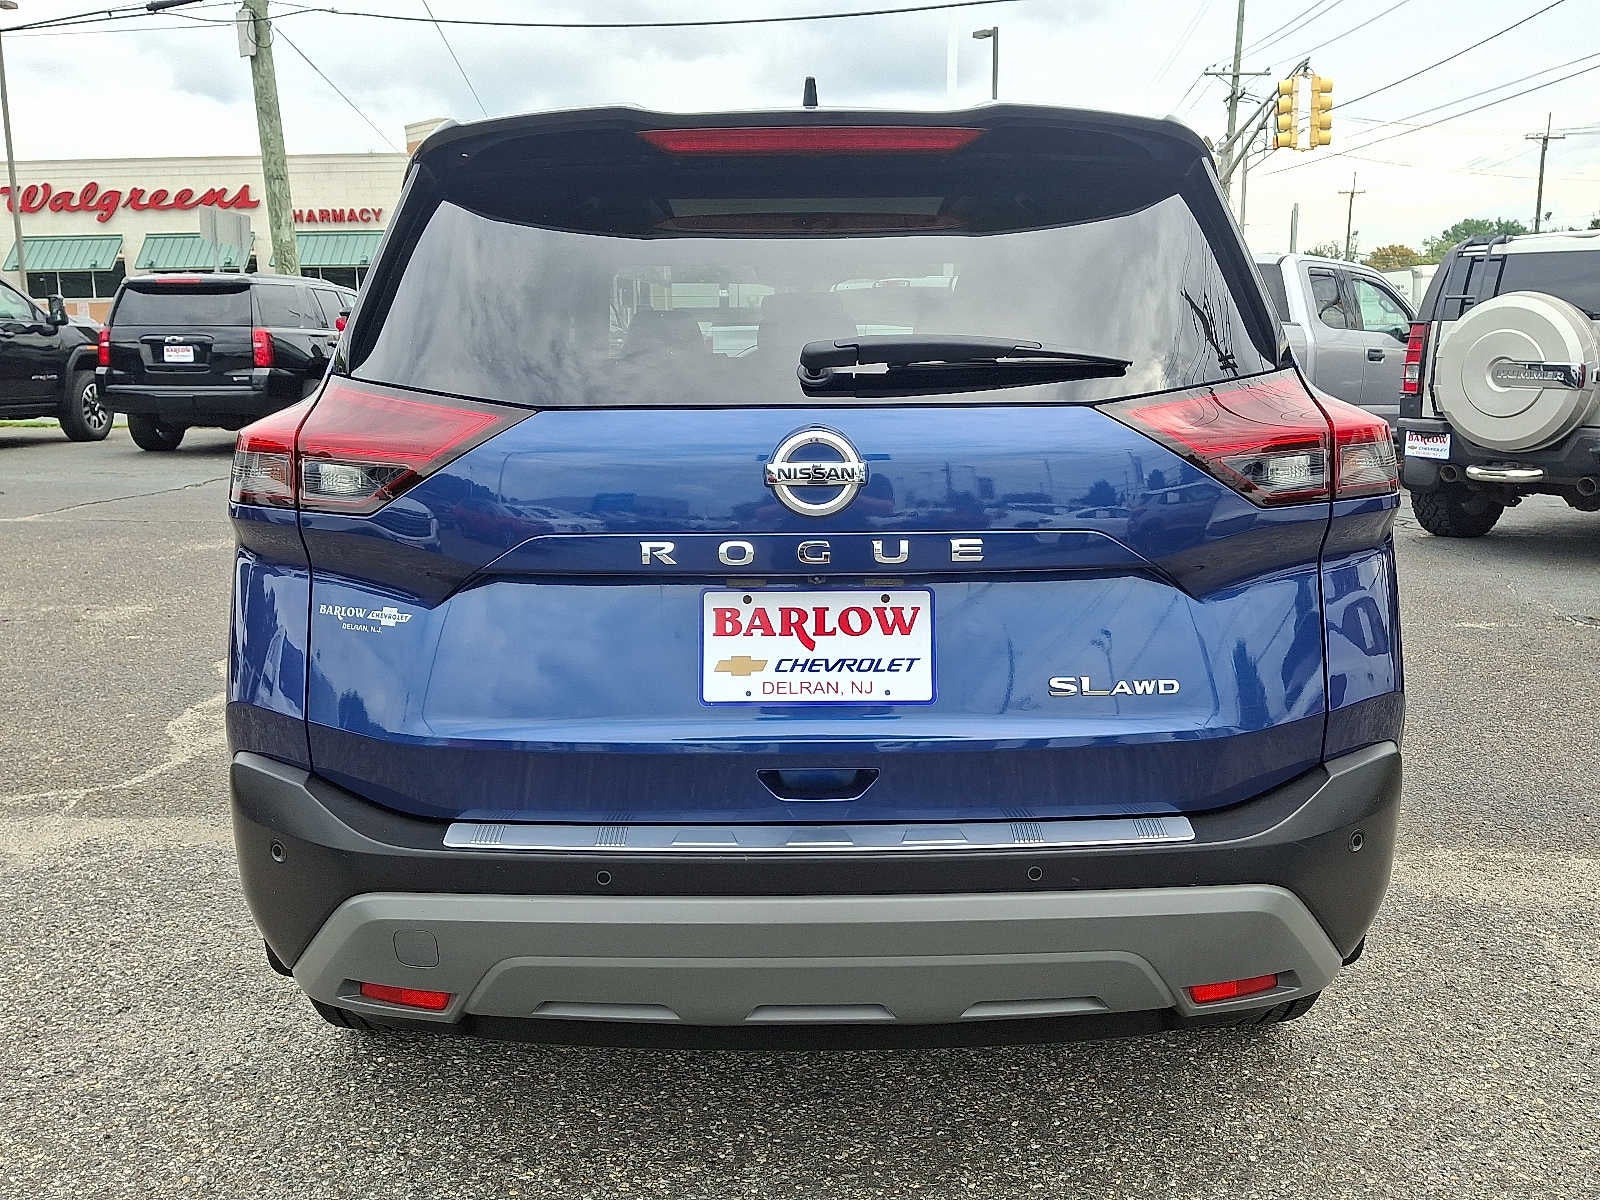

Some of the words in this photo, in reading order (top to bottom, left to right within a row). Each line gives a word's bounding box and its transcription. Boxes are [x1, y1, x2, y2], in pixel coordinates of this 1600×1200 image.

[0, 181, 261, 224] Walgreens
[292, 207, 383, 224] HARMACY
[1496, 369, 1565, 381] HUMMER
[1408, 432, 1448, 446] BARLOW
[776, 466, 856, 482] NISSAN
[638, 537, 985, 567] ROGUE
[319, 604, 368, 621] BARLOW
[370, 610, 410, 622] CHEVROLET
[712, 606, 921, 652] BARLOW
[774, 656, 922, 674] CHEVROLET
[761, 680, 845, 697] DELRAN,
[850, 680, 874, 695] NJ
